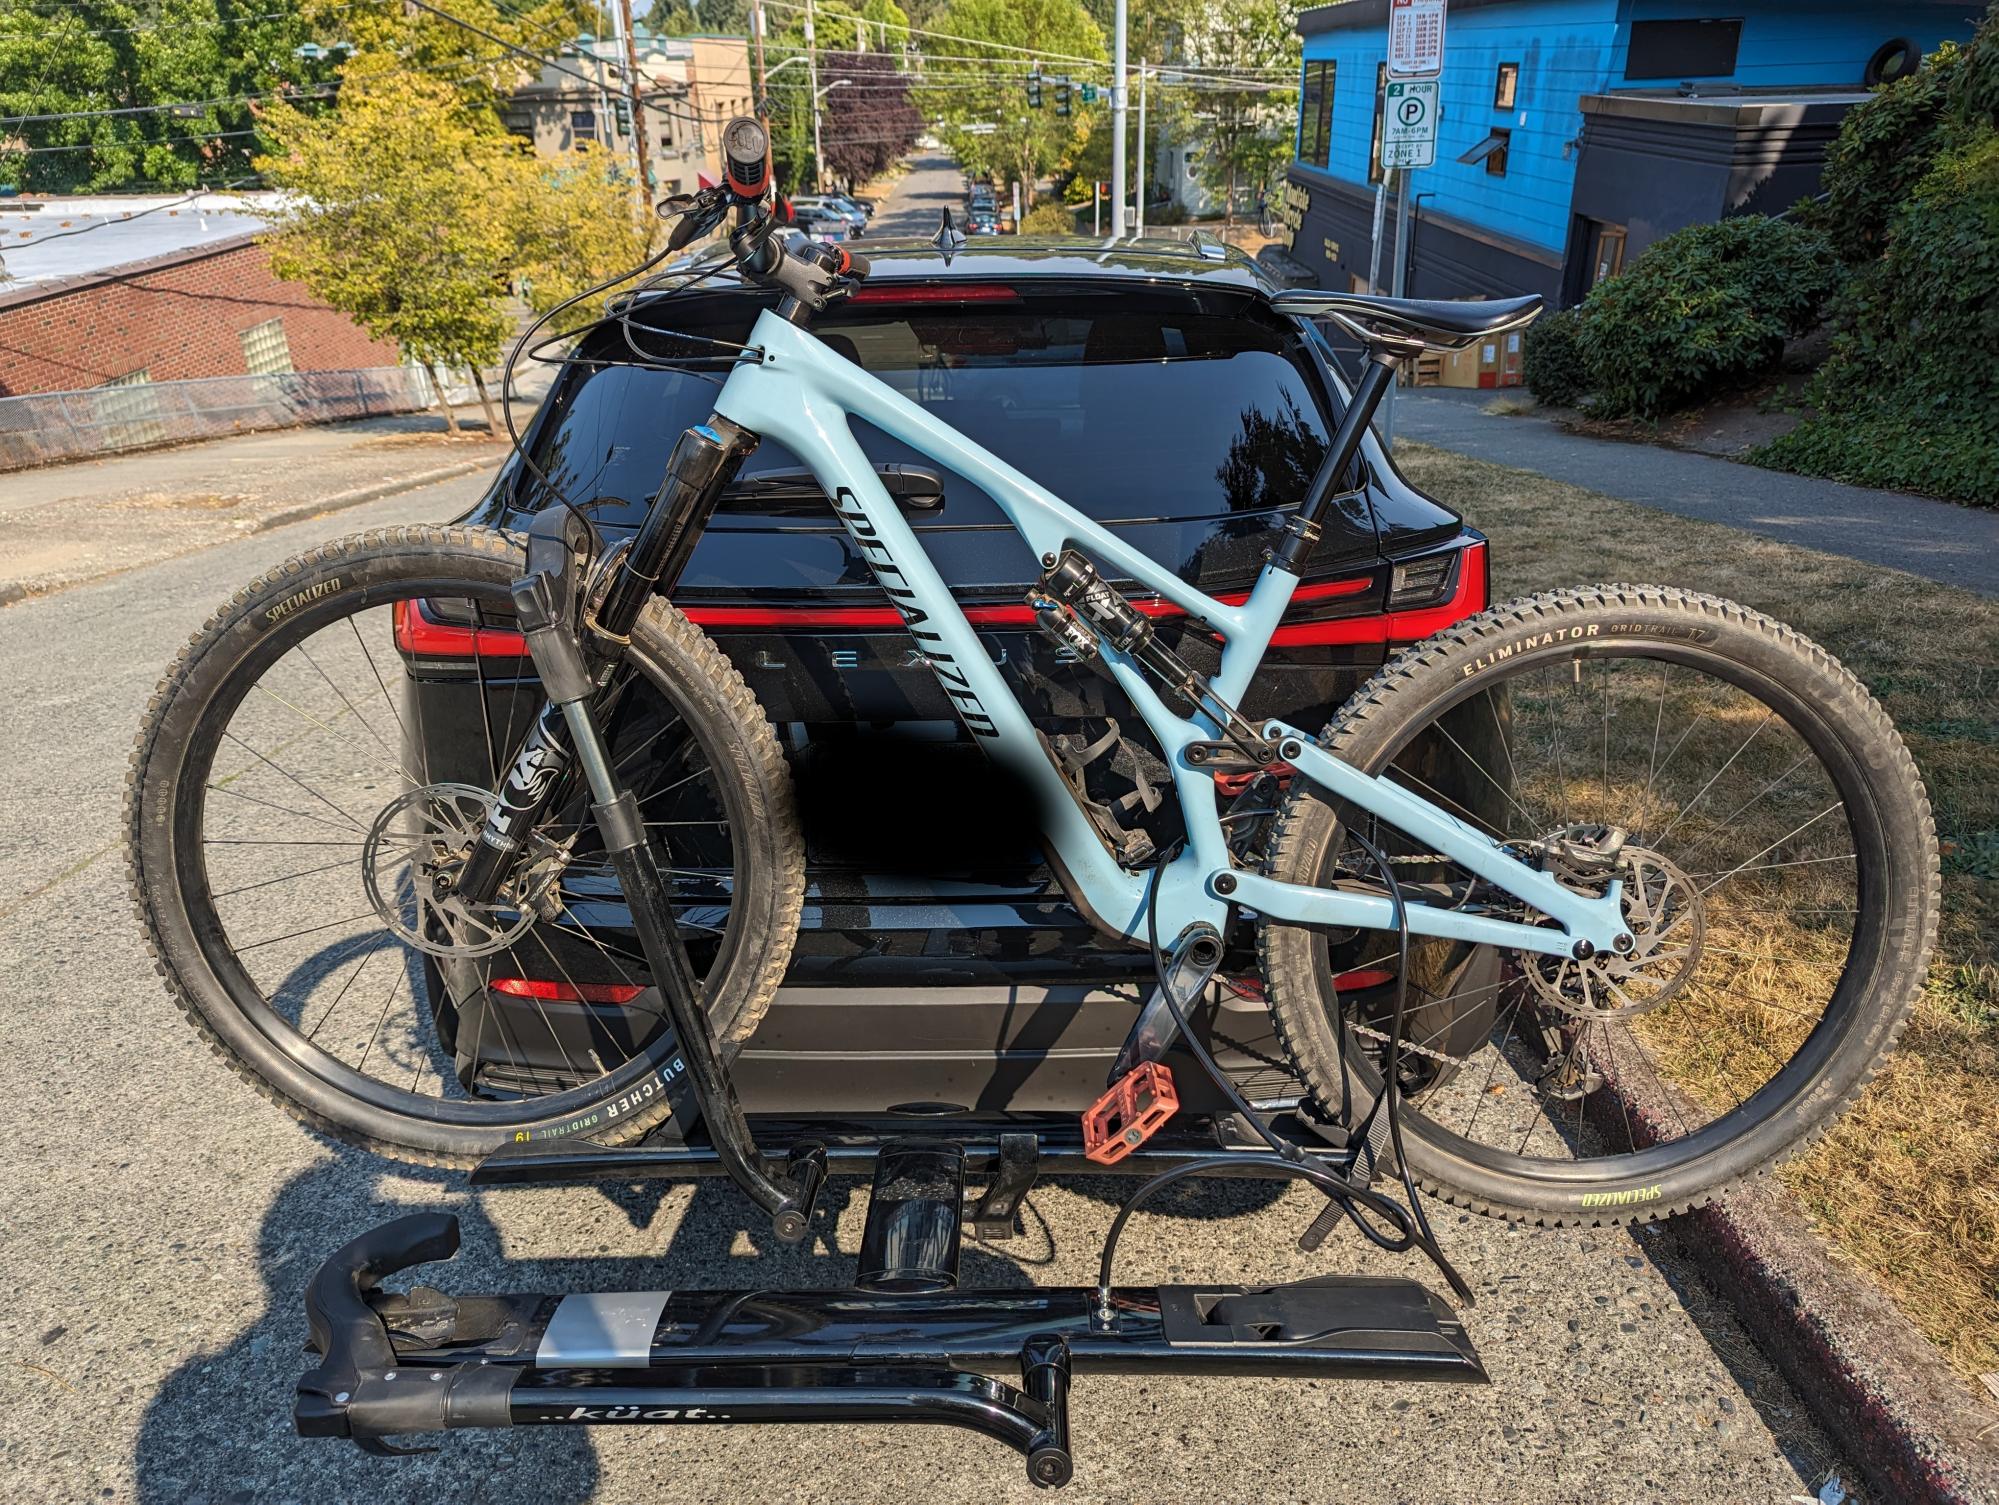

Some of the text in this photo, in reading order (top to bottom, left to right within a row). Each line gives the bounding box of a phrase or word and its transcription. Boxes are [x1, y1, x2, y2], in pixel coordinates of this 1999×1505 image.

[1393, 85, 1433, 96] 2 HOUR
[1406, 103, 1419, 120] P
[1392, 126, 1429, 136] 7AM-6PM
[1388, 149, 1414, 159] ZONE
[264, 577, 341, 625] SPECIALIZED
[1085, 589, 1112, 602] FLOAT
[832, 486, 1001, 738] SPECIALIZED
[1064, 624, 1090, 651] FOX
[1463, 624, 1601, 678] ELIMINATOR
[606, 1057, 686, 1119] BUTCHER
[1582, 1183, 1662, 1207] SPECIALIZED
